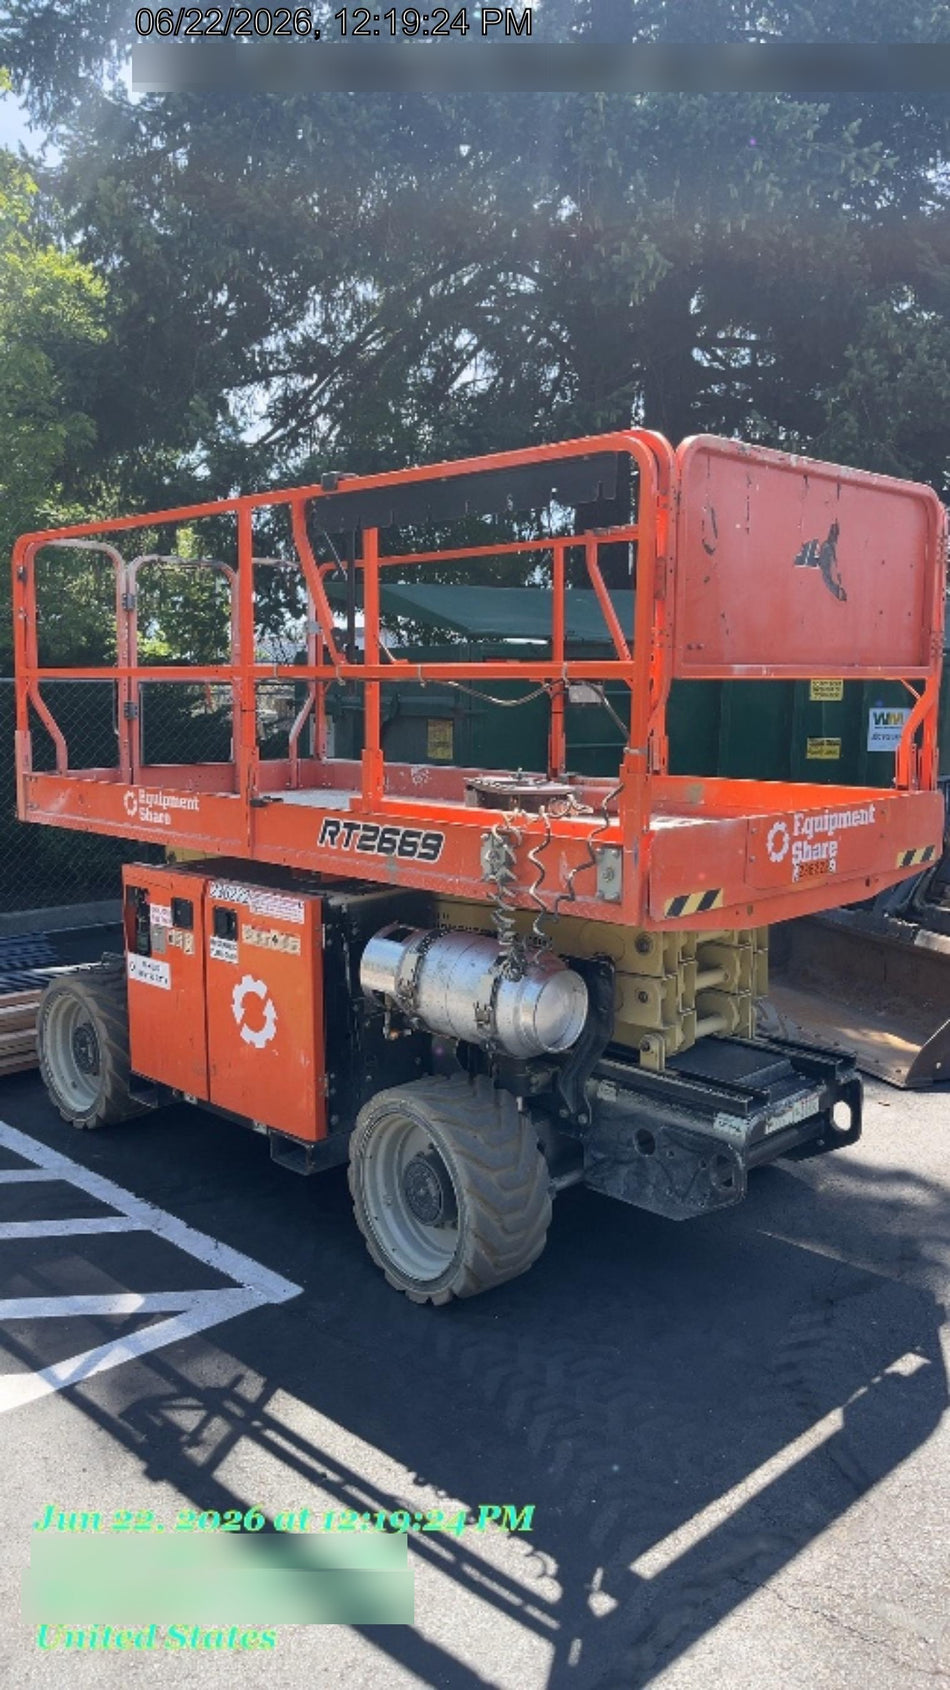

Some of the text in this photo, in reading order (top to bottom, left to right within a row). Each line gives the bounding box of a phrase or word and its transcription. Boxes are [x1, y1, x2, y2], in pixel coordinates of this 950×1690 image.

[138, 789, 200, 813] Equipment
[793, 805, 875, 838] Equipment
[318, 818, 445, 863] RT2669
[792, 839, 837, 863] Share
